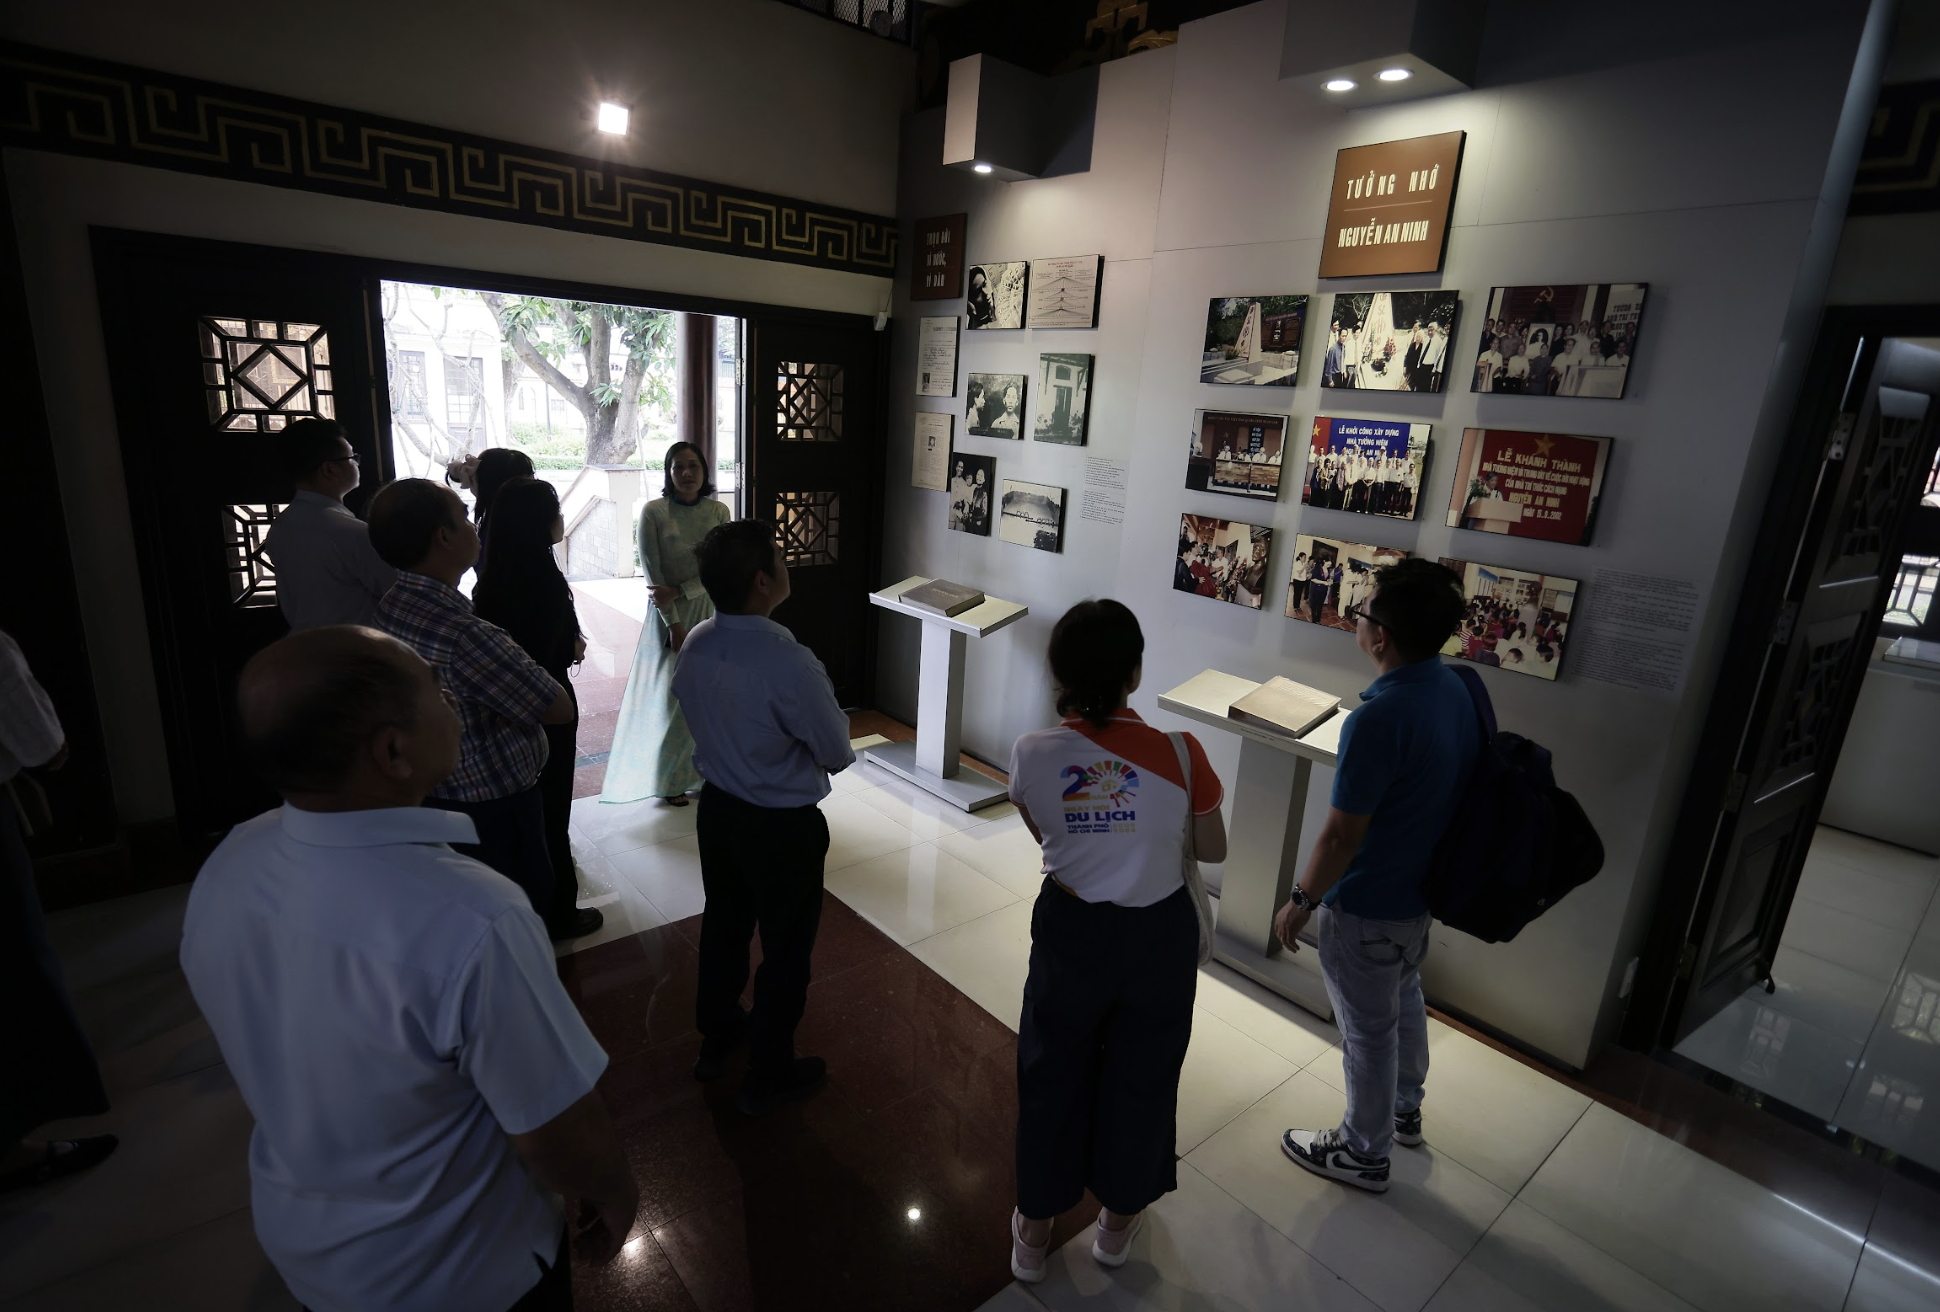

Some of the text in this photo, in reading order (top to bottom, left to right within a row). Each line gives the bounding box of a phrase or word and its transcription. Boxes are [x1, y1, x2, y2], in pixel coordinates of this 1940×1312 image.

[1347, 163, 1439, 200] TƯỞNG NHỚ
[1338, 217, 1429, 248] NGUYỄN AN NINH
[1359, 427, 1372, 436] CÔNG
[1374, 428, 1384, 436] XÂY
[1497, 448, 1512, 462] LỄ
[1552, 458, 1582, 473] THÀNH
[1065, 811, 1135, 823] DU LỊCH
